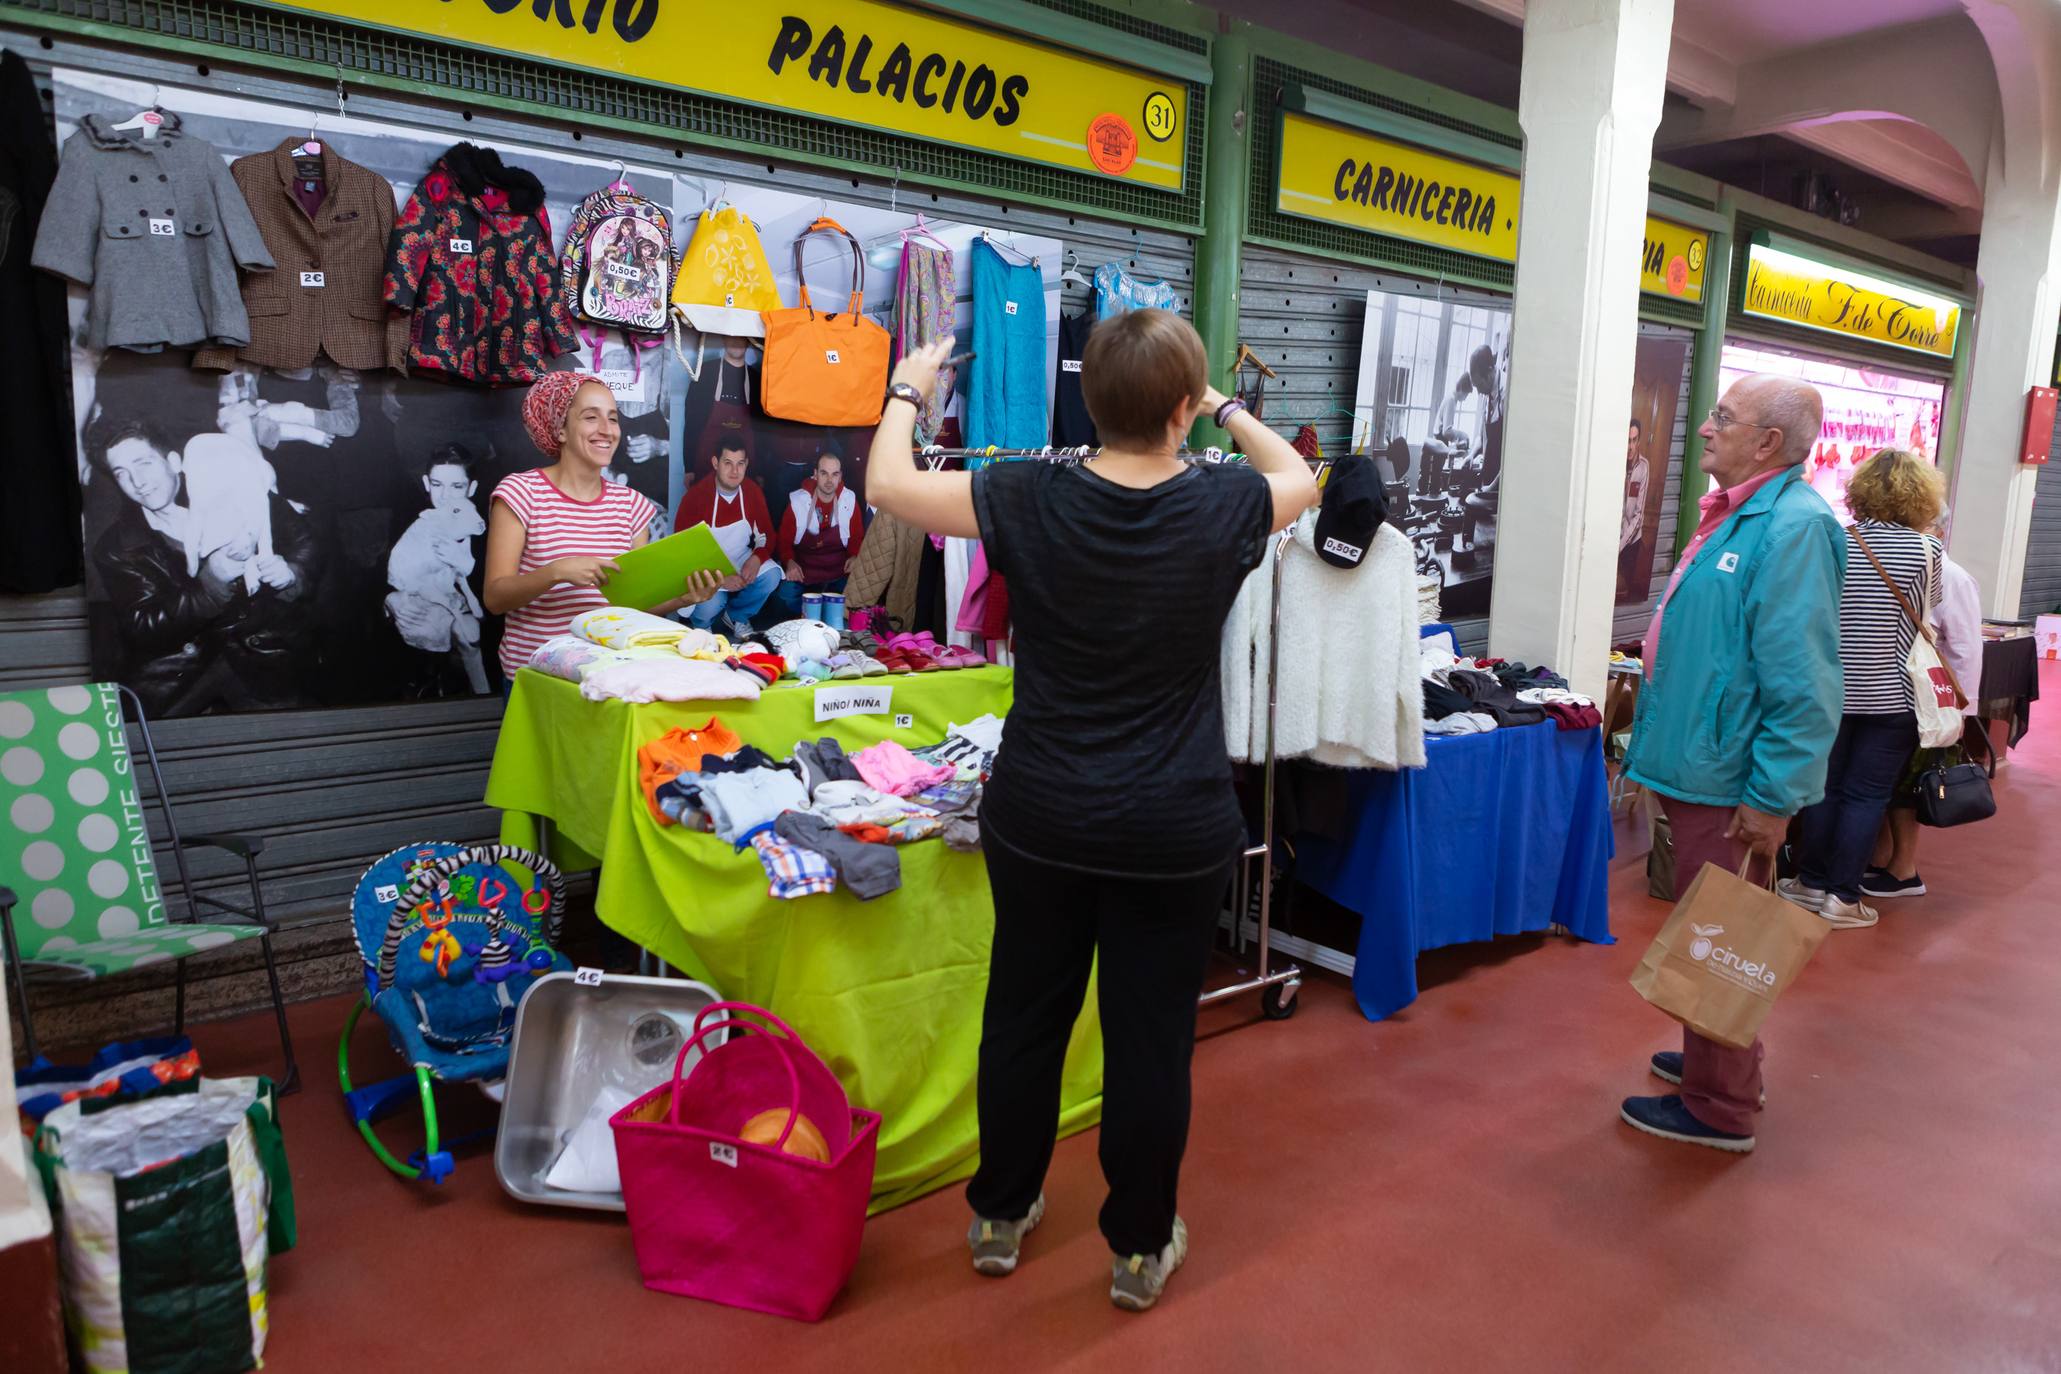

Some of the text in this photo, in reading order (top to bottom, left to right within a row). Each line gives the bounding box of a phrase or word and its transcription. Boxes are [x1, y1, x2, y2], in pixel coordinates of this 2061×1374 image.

[768, 16, 1029, 126] PALACIOS
[1151, 104, 1170, 129] 31
[1334, 158, 1496, 236] CARNICERIA
[153, 223, 173, 234] 3€
[452, 242, 470, 251] 4€
[610, 264, 637, 278] 0,50€
[304, 273, 322, 283] 2€
[1007, 305, 1016, 313] 1€
[1877, 297, 1939, 348] Torre
[828, 354, 838, 362] 1€
[1208, 450, 1220, 461] 1€
[1326, 539, 1359, 558] 0,50€
[853, 696, 881, 708] NIÑA
[896, 716, 909, 725] 1€
[378, 890, 397, 901] 3€
[1711, 946, 1776, 986] ciruela
[578, 971, 599, 983] 4€
